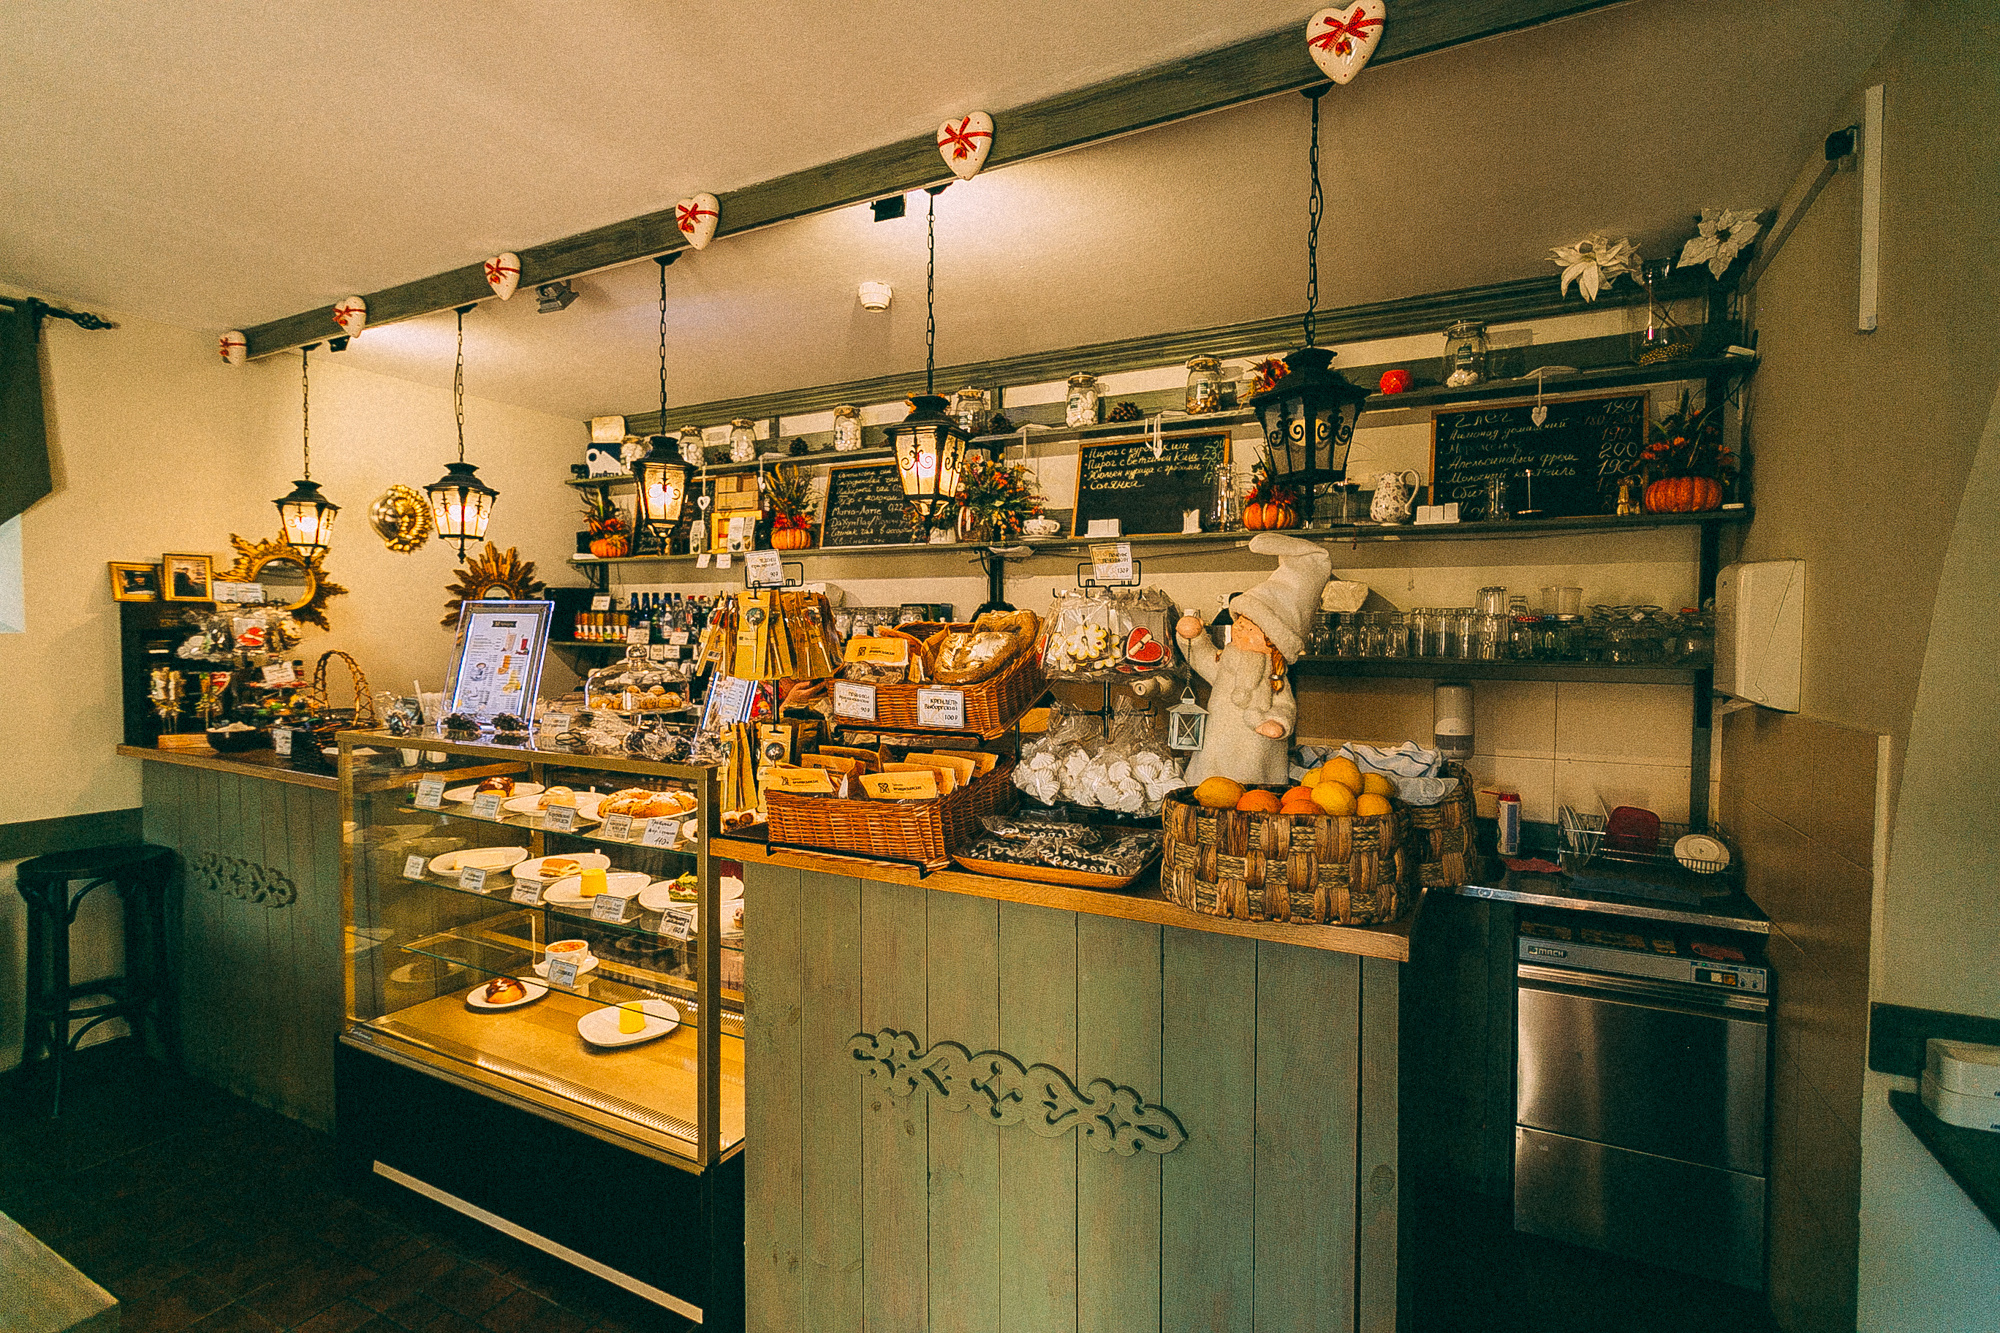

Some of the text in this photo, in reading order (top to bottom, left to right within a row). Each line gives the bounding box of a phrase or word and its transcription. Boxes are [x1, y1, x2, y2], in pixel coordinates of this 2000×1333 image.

[1088, 447, 1119, 460] Пирог
[1128, 446, 1160, 460] куро
[1598, 442, 1639, 458] 200
[1087, 459, 1117, 472] Пирог
[1174, 451, 1200, 464] Киш
[924, 703, 958, 711] Выборгский
